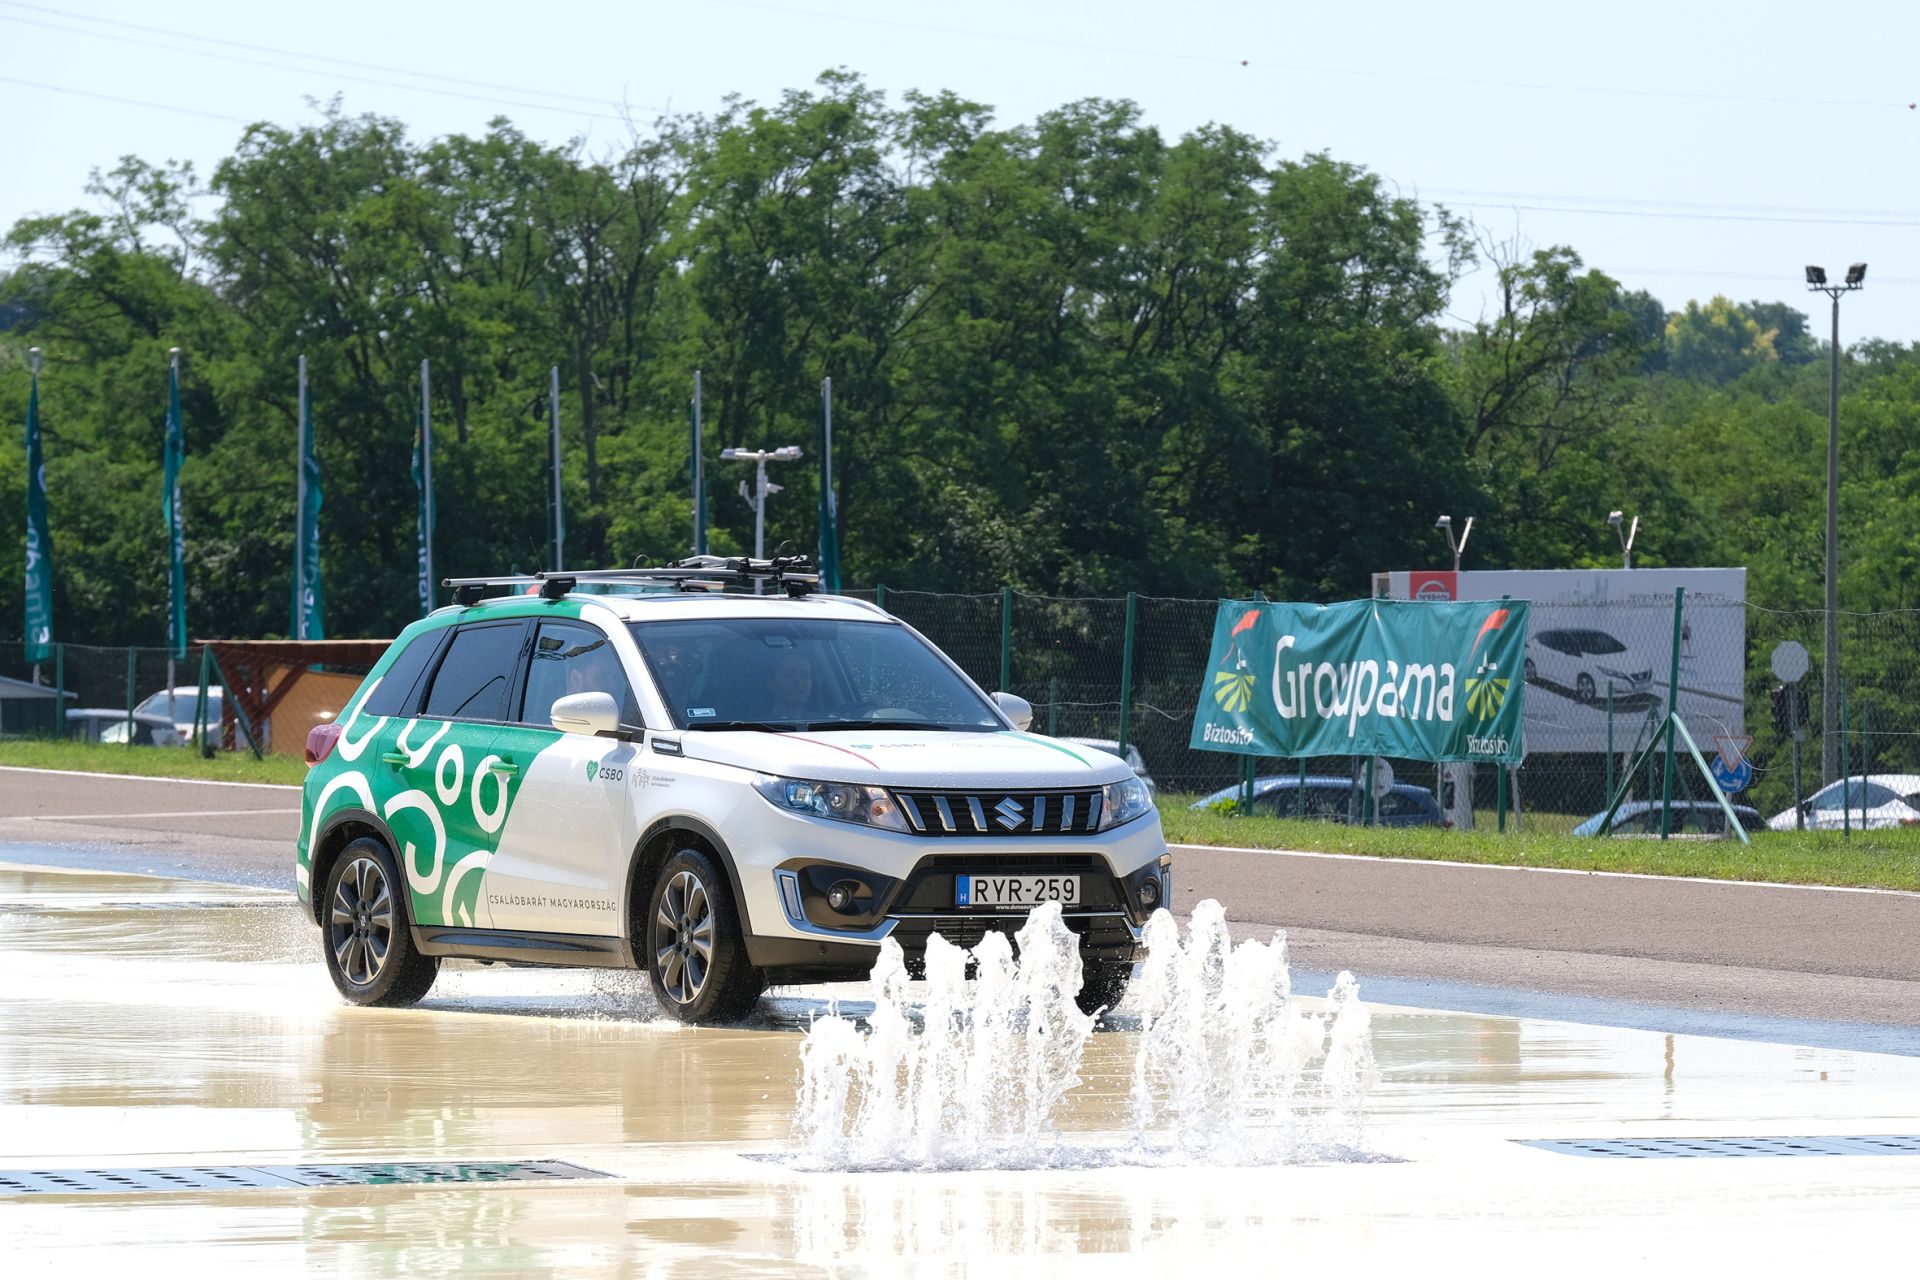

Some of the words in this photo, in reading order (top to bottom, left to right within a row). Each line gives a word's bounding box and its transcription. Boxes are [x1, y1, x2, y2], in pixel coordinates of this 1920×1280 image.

[1272, 635, 1455, 737] Groupama
[1203, 722, 1254, 746] Biztosító
[599, 767, 623, 781] CSBO
[960, 893, 967, 902] H
[975, 879, 1074, 902] RYR-259
[489, 893, 547, 907] CSALÁDBARÁT
[550, 898, 616, 911] MAGYARORSZÁG
